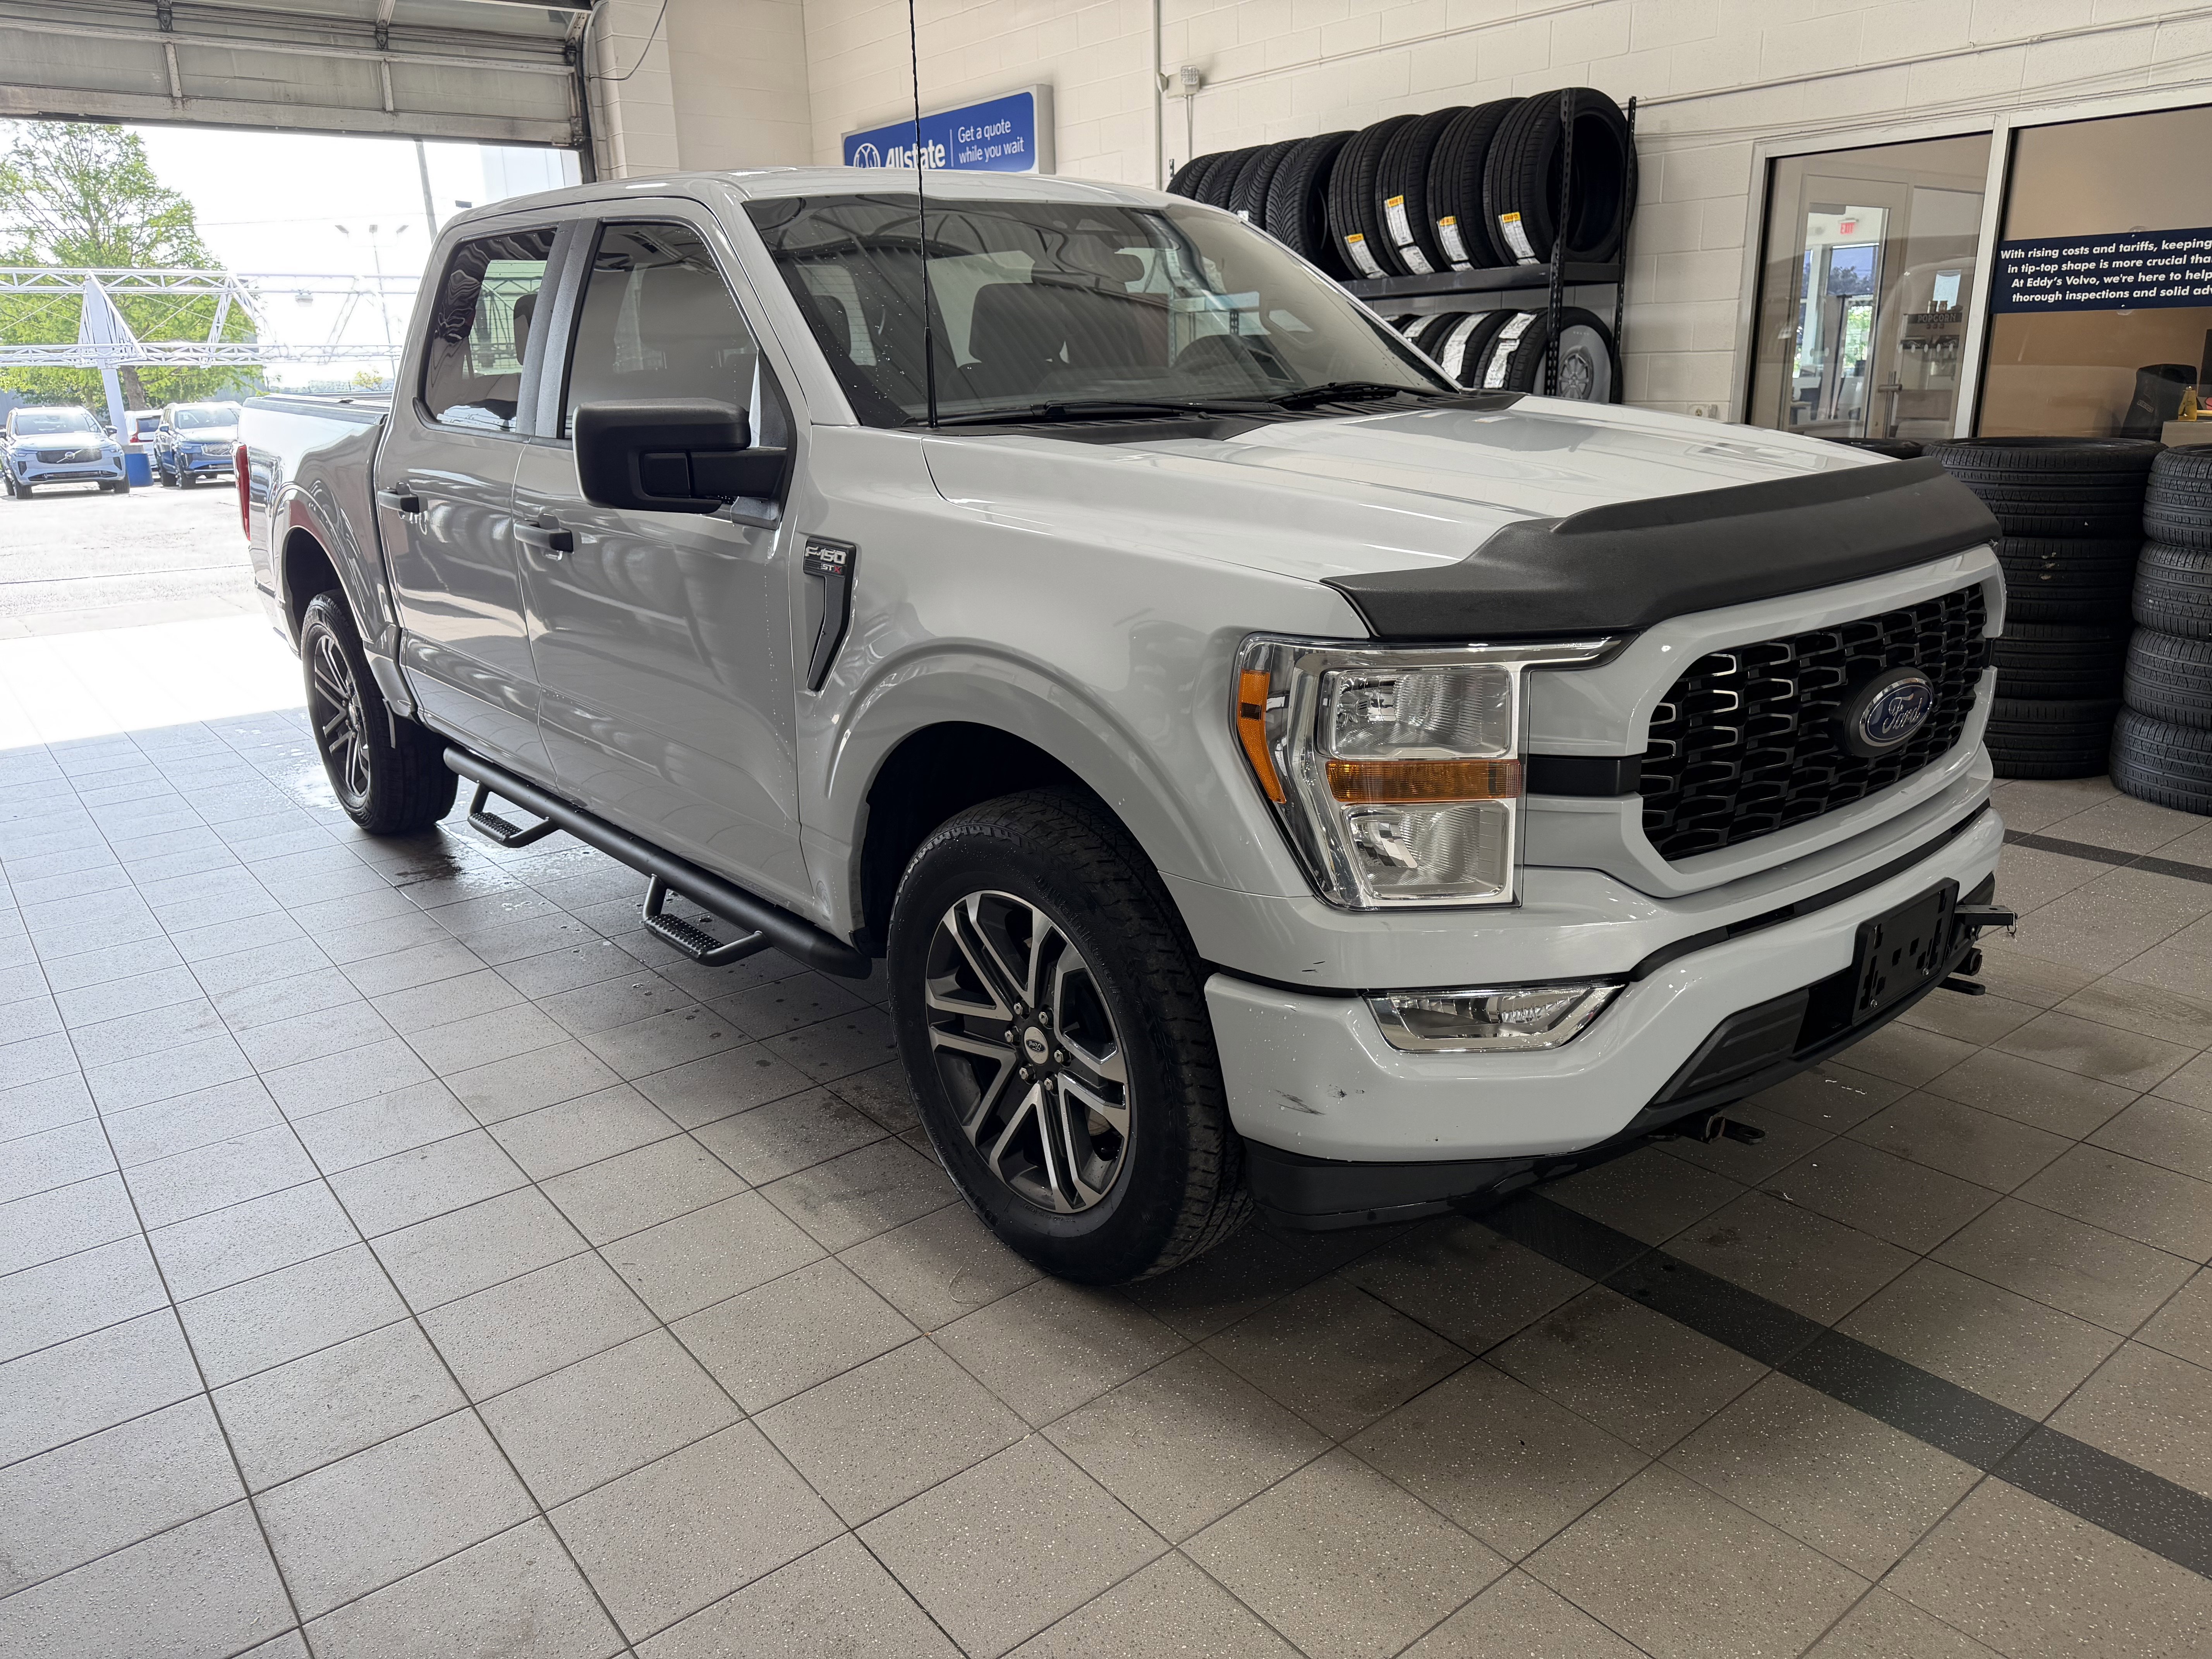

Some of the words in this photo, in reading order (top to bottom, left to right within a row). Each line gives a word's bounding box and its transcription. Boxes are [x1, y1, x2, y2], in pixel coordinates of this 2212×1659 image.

[958, 125, 975, 143] Get
[976, 127, 982, 139] a
[984, 118, 1011, 140] quote
[885, 139, 946, 169] Allstate
[958, 145, 983, 163] while
[984, 144, 1002, 163] you
[1003, 136, 1024, 155] wait
[2001, 249, 2025, 259] With
[2028, 247, 2059, 258] rising
[2063, 246, 2089, 256] costs
[2093, 243, 2116, 254] and
[2119, 240, 2158, 252] tariffs,
[2162, 239, 2212, 251] keeping
[2008, 264, 2018, 273] in
[2021, 263, 2058, 275] tip-top
[2061, 261, 2096, 272] shape
[2100, 259, 2109, 268] is
[2112, 259, 2143, 268] more
[2147, 254, 2187, 266] crucial
[2191, 254, 2212, 264] tha
[2011, 279, 2024, 288] At
[2066, 275, 2100, 285] Volvo,
[2104, 274, 2135, 283] we're
[2138, 272, 2166, 282] here
[2170, 272, 2181, 280] to
[2185, 269, 2212, 281] help
[2013, 291, 2062, 303] thorough
[2066, 289, 2130, 301] inspections
[2133, 287, 2157, 297] and
[2160, 285, 2190, 296] solid
[1918, 313, 1956, 323] POPCORN
[805, 546, 847, 564] F-150
[821, 563, 843, 574] STX
[1882, 693, 1923, 734] Ford
[1029, 1041, 1042, 1051] Ford
